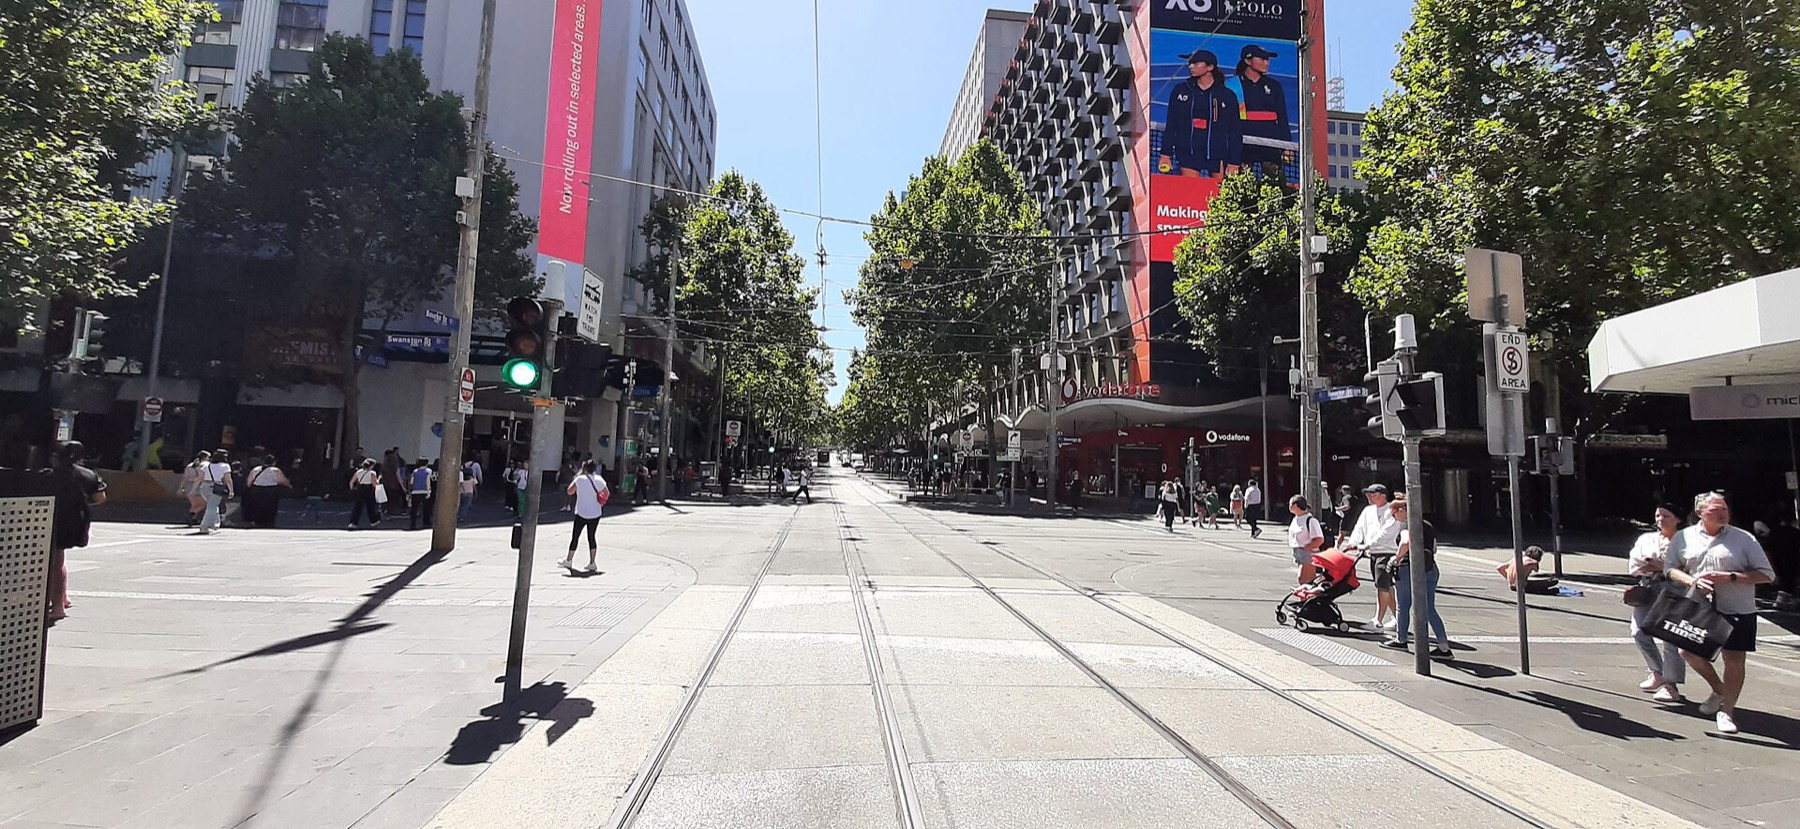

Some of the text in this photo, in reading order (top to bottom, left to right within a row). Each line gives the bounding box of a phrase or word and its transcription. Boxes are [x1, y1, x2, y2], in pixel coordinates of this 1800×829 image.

[1236, 1, 1283, 15] POLO
[568, 41, 583, 99] selected
[566, 100, 578, 114] in
[566, 114, 578, 138] out
[563, 138, 579, 181] rolling
[559, 183, 573, 214] Now
[1157, 205, 1208, 222] Making
[387, 336, 423, 345] Swanston
[423, 337, 432, 345] St
[1502, 335, 1521, 345] END
[1082, 381, 1160, 398] vodafone
[1501, 377, 1526, 388] AREA
[1766, 394, 1800, 405] mic
[1218, 433, 1250, 442] vodafone
[1663, 620, 1704, 644] Times
[1678, 619, 1708, 638] Fast
